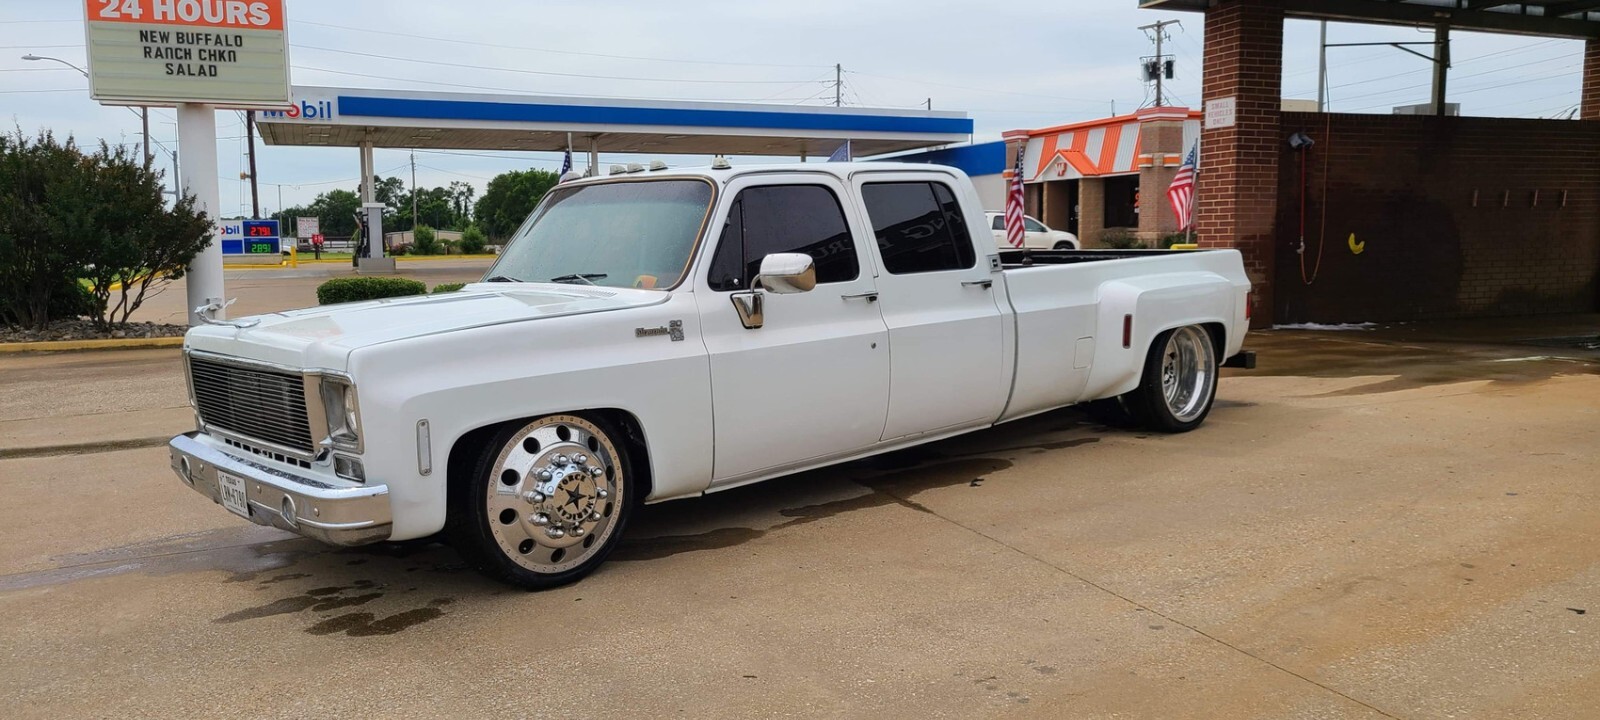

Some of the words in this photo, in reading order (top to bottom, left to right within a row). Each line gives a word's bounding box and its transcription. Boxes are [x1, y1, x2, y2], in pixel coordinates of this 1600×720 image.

[99, 0, 143, 19] 24
[152, 0, 271, 26] HOURS
[139, 29, 170, 45] NEW
[176, 31, 243, 48] BUFFALO
[143, 46, 192, 61] RANCH
[165, 62, 218, 78] SALAD
[1211, 101, 1229, 110] SMALL
